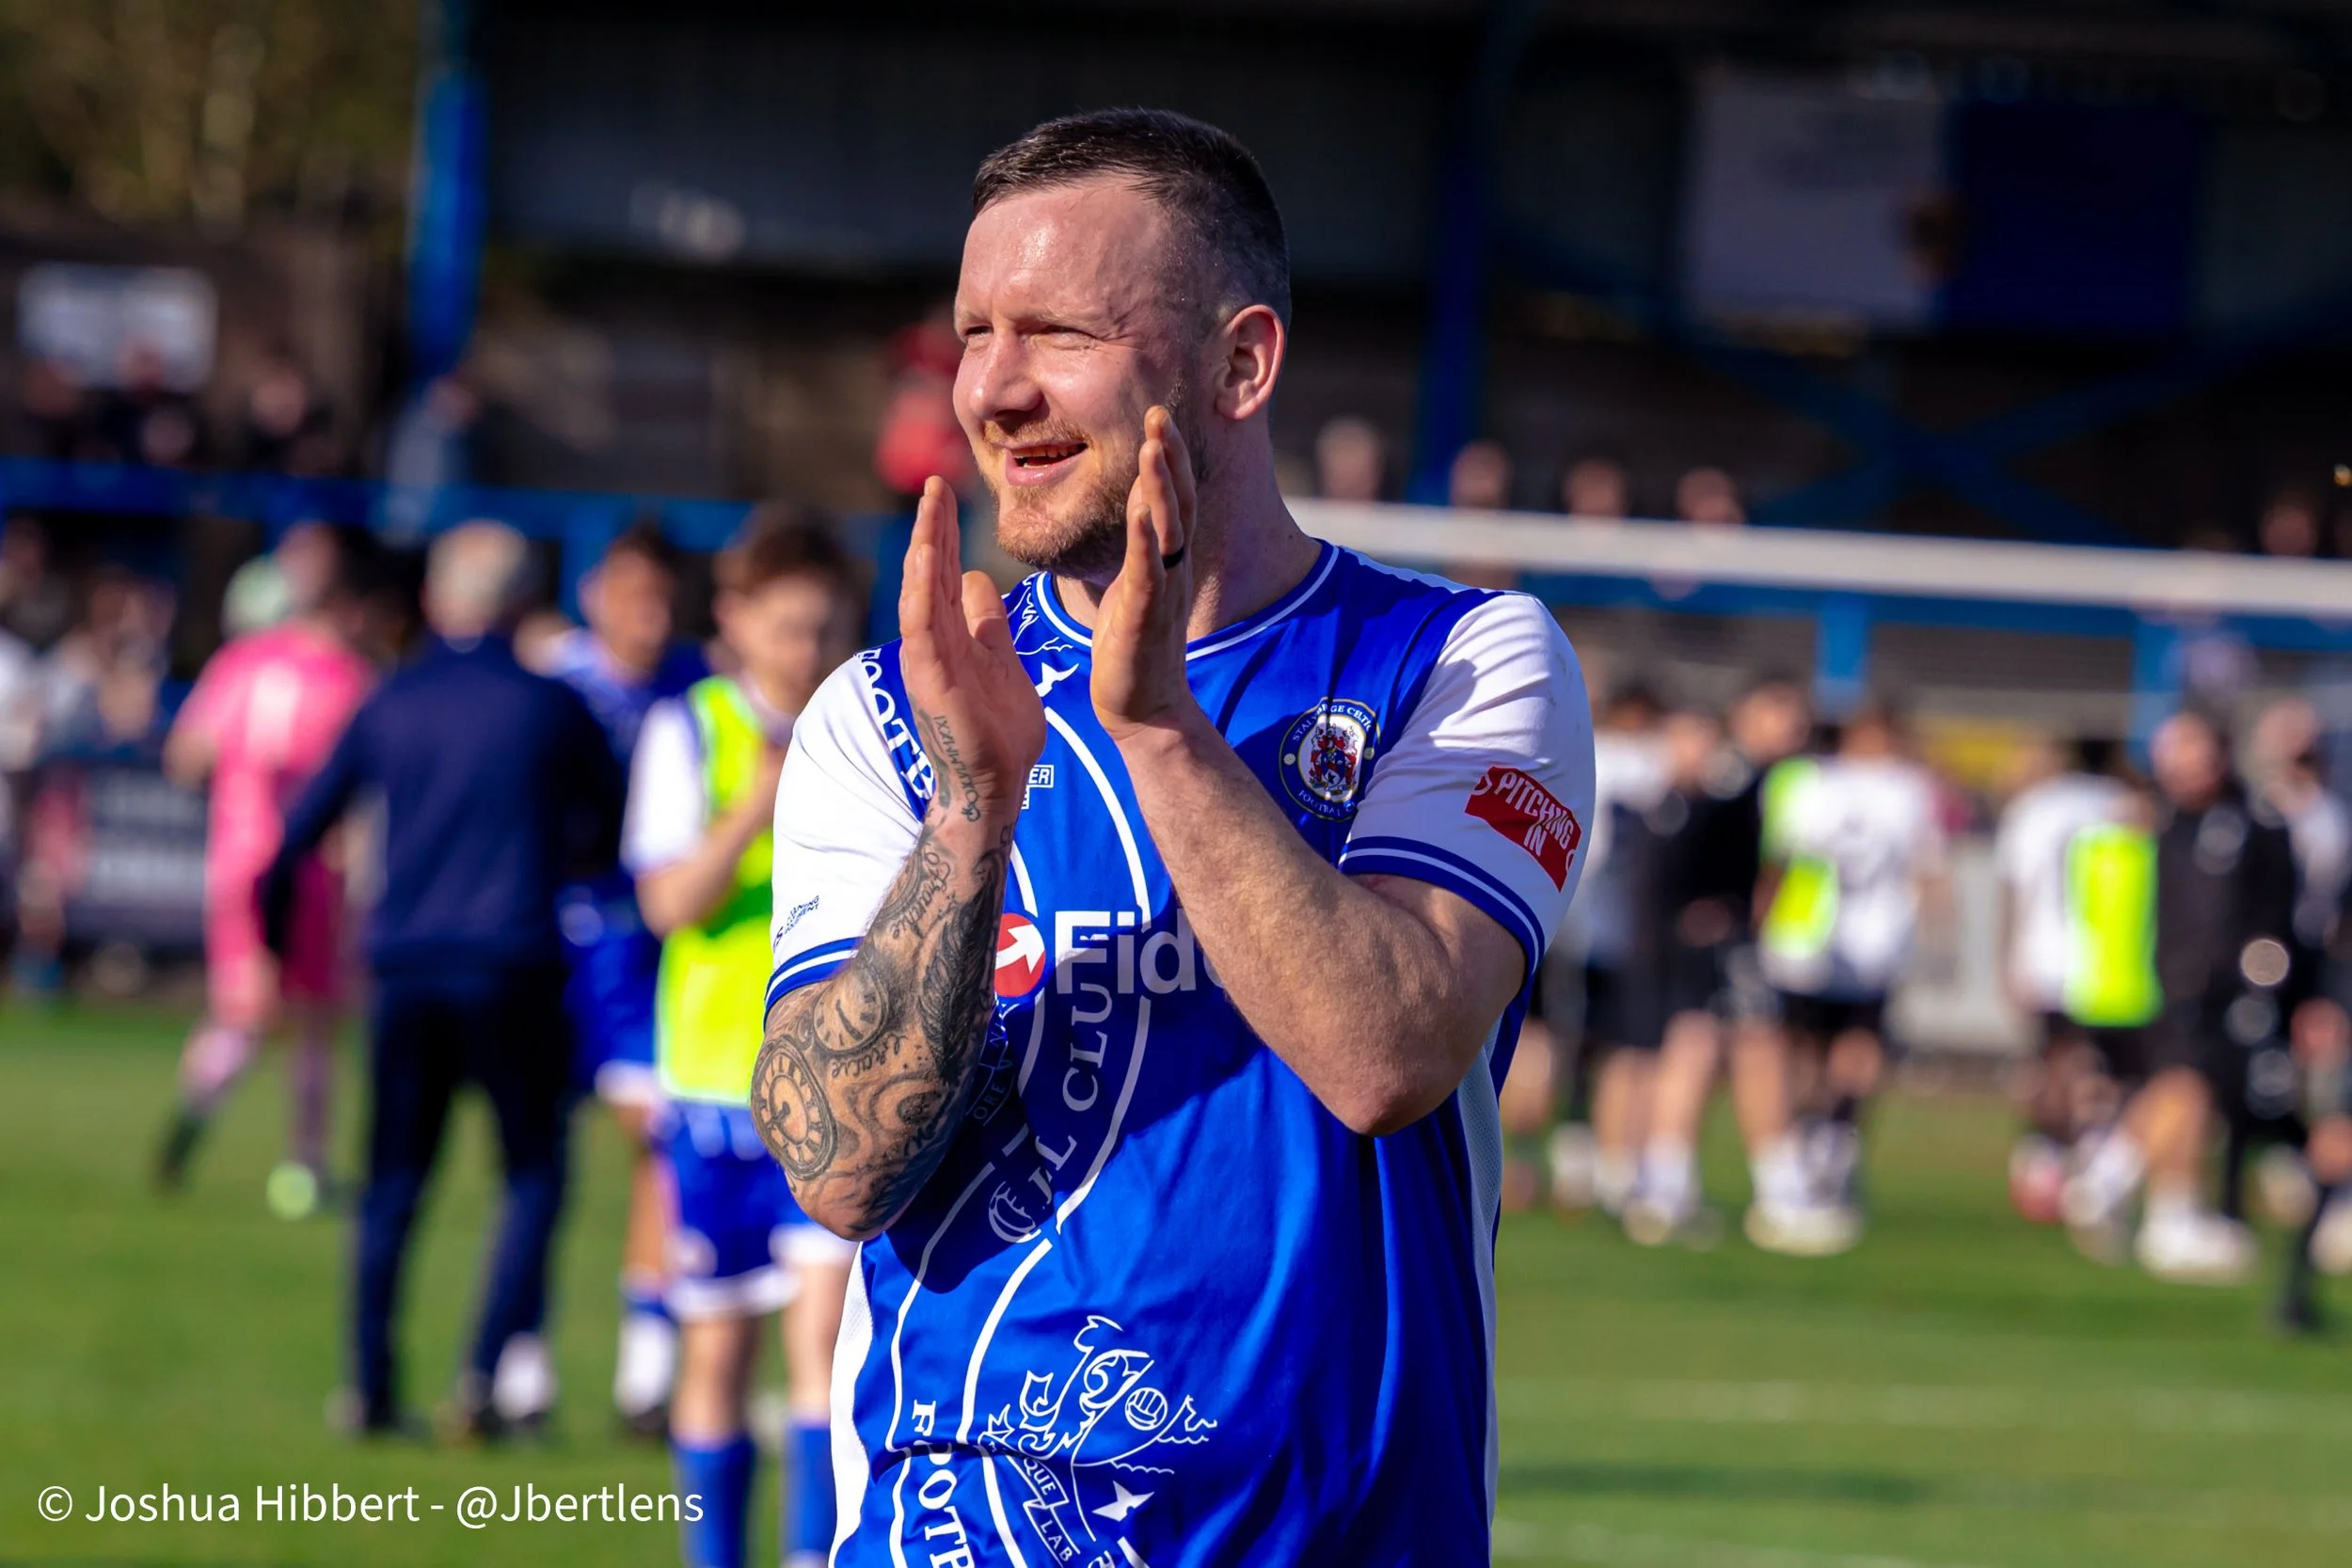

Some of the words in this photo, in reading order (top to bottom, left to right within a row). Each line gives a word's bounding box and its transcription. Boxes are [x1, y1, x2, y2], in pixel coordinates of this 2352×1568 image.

[1493, 771, 1574, 849] PITCHING
[1523, 824, 1548, 857] IN
[1062, 982, 1113, 1112] CLU
[1024, 1458, 1056, 1496] QUE
